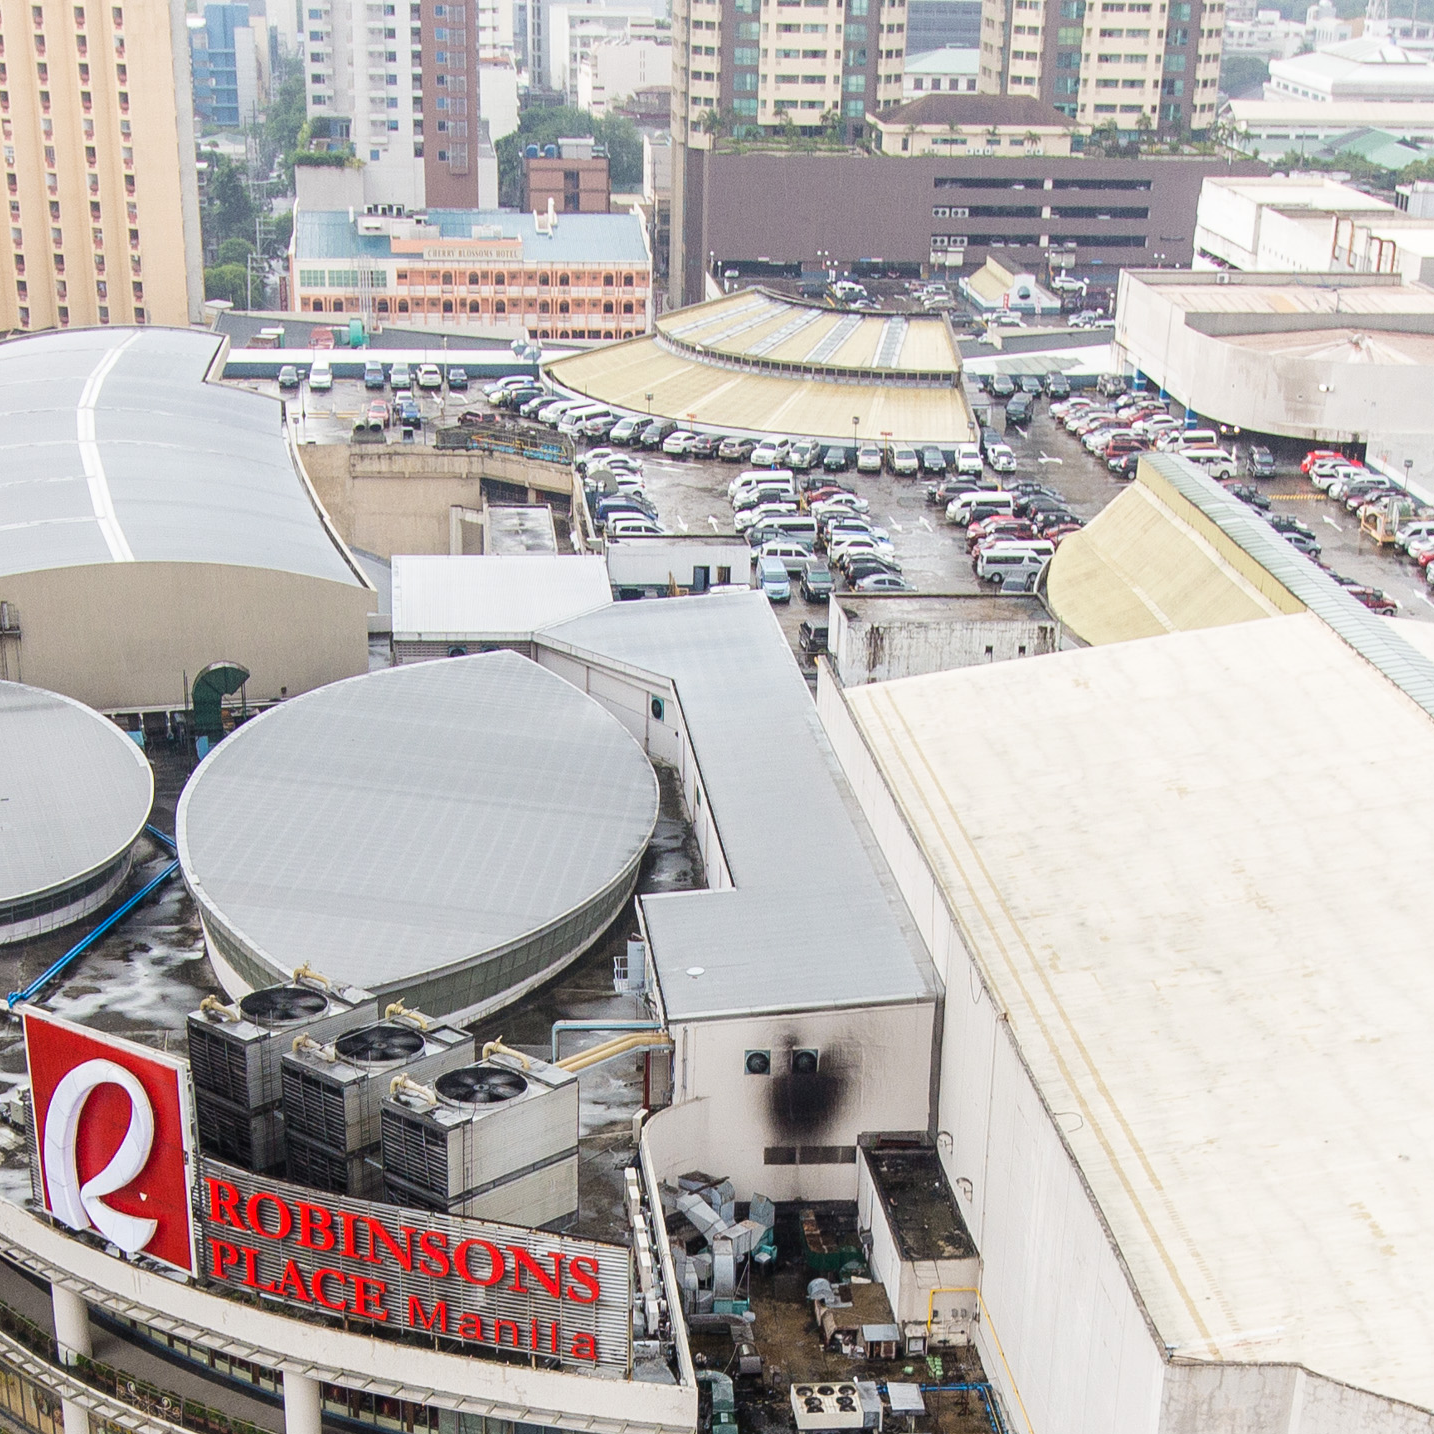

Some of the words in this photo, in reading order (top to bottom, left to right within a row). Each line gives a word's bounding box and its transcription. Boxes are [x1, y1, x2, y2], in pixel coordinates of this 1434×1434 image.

[204, 1177, 601, 1304] ROBINSONS
[206, 1237, 390, 1322] PLACE
[408, 1294, 600, 1361] Manila
